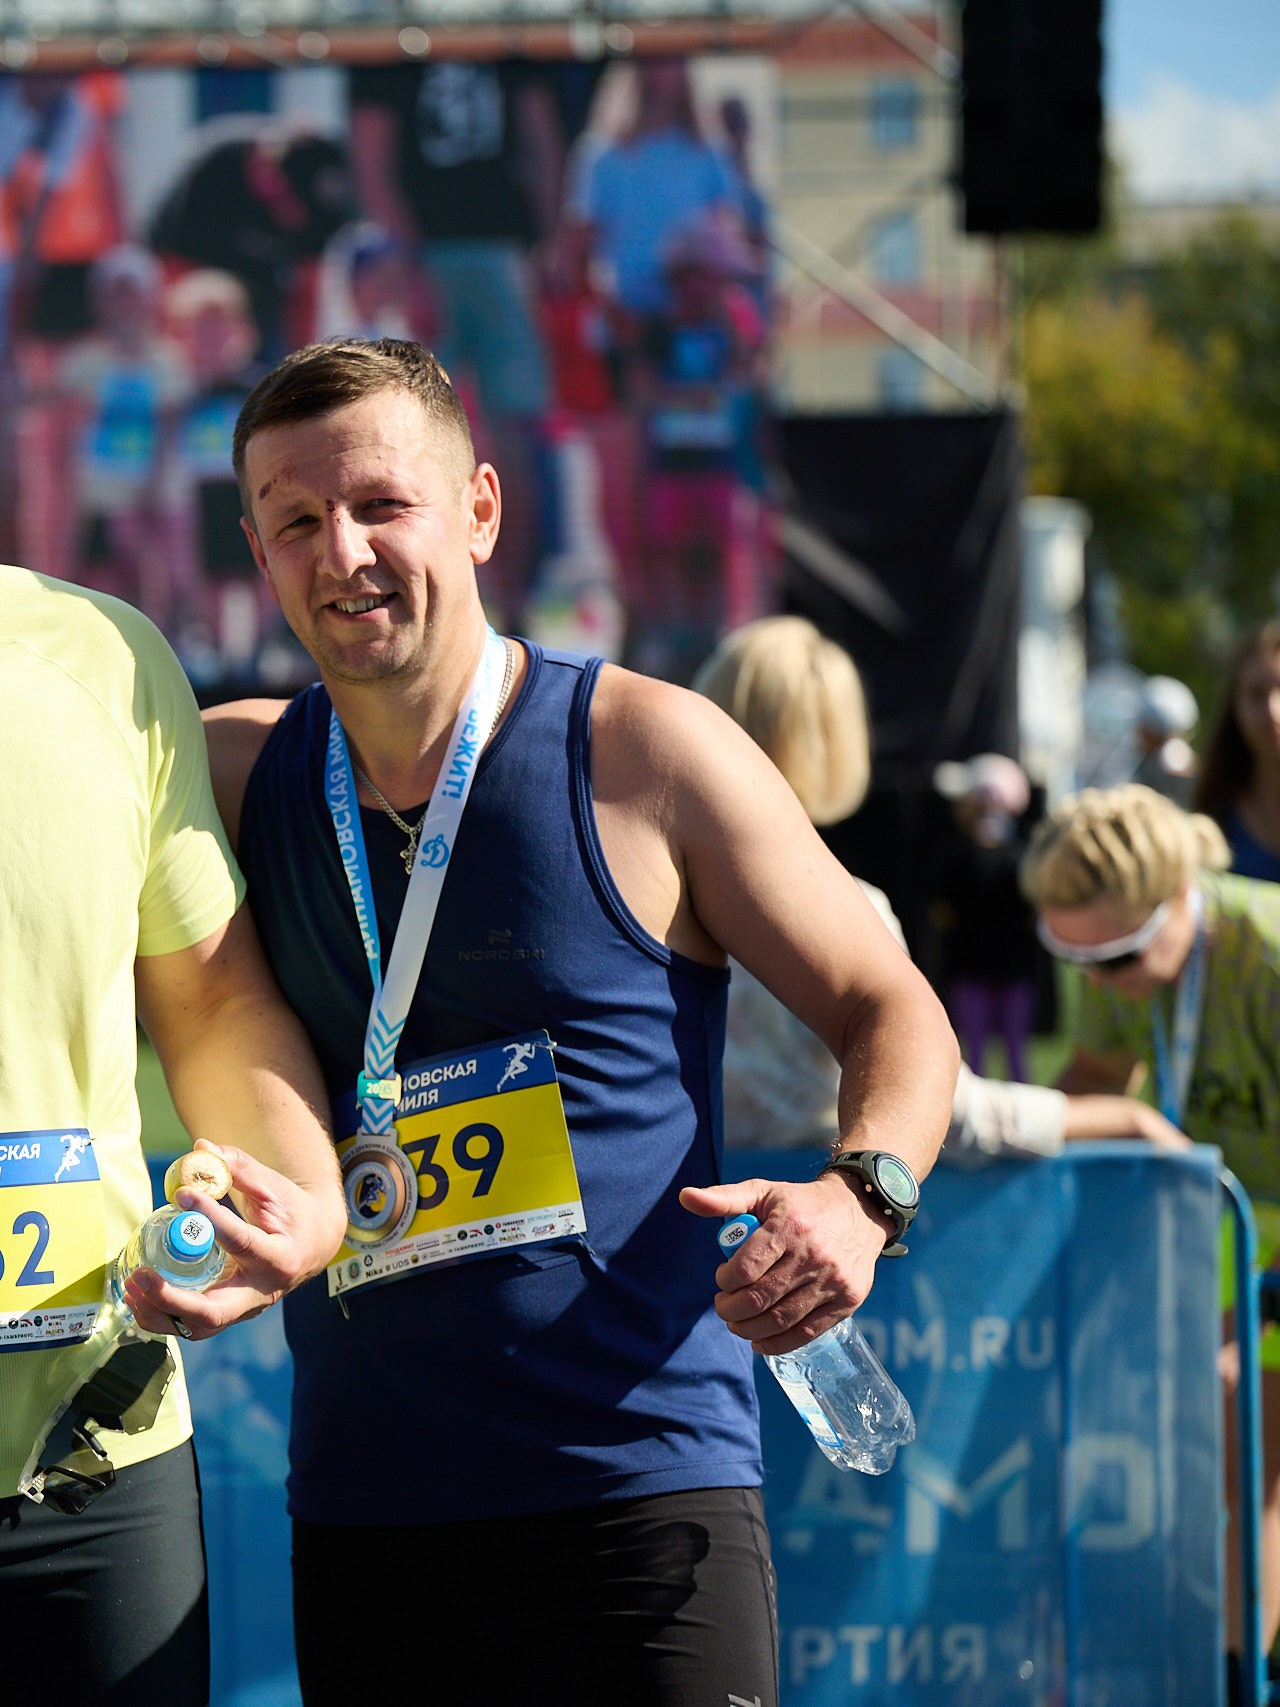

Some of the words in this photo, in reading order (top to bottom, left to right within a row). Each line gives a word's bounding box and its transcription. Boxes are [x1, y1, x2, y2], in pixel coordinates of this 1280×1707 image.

[403, 1058, 477, 1092] ОВСКАЯ
[402, 1122, 505, 1210] 39
[365, 1268, 384, 1278] Nika
[392, 1259, 410, 1270] UDS
[786, 1622, 988, 1687] РТИЯ
